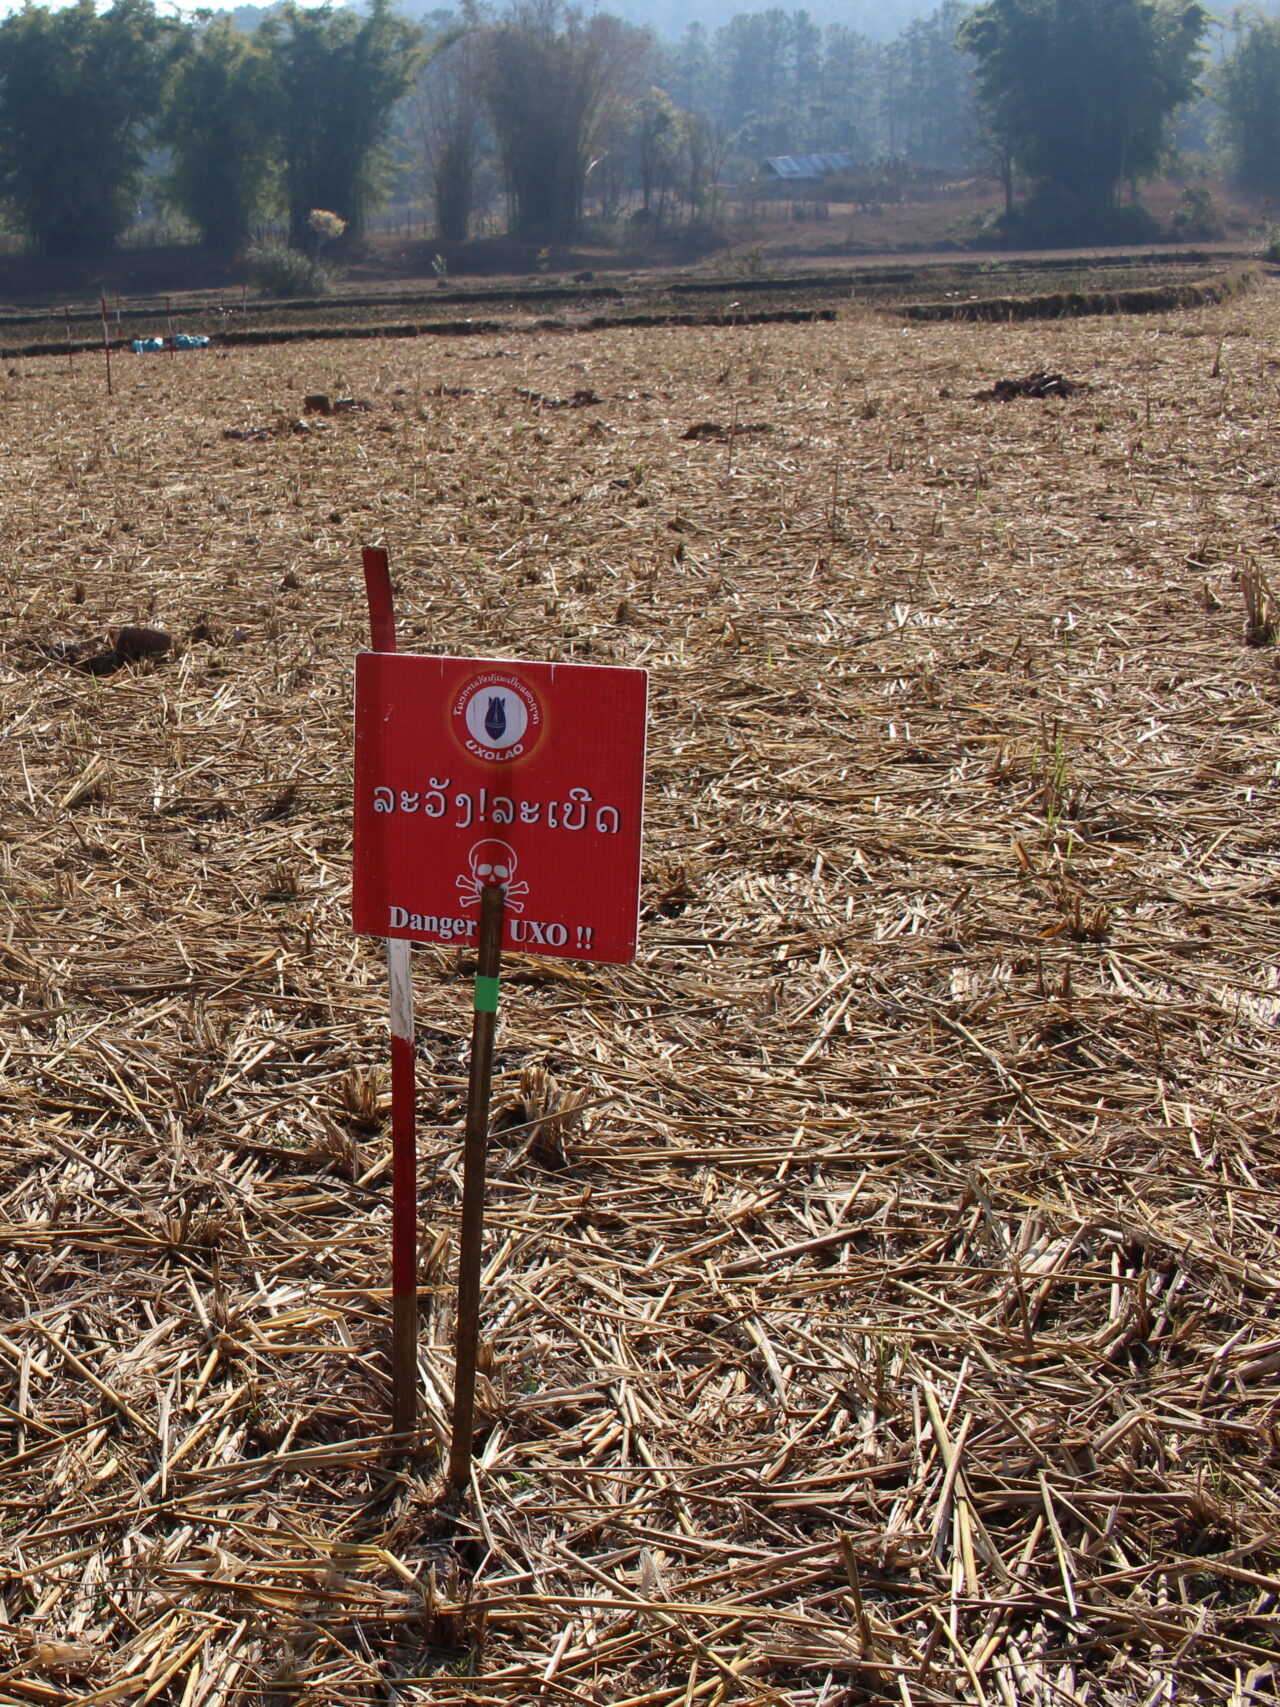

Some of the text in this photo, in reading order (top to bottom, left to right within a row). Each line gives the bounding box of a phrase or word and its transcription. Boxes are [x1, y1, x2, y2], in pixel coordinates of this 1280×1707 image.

[465, 739, 524, 760] UXOLAO
[389, 906, 478, 938] Danger
[510, 919, 568, 946] UXO
